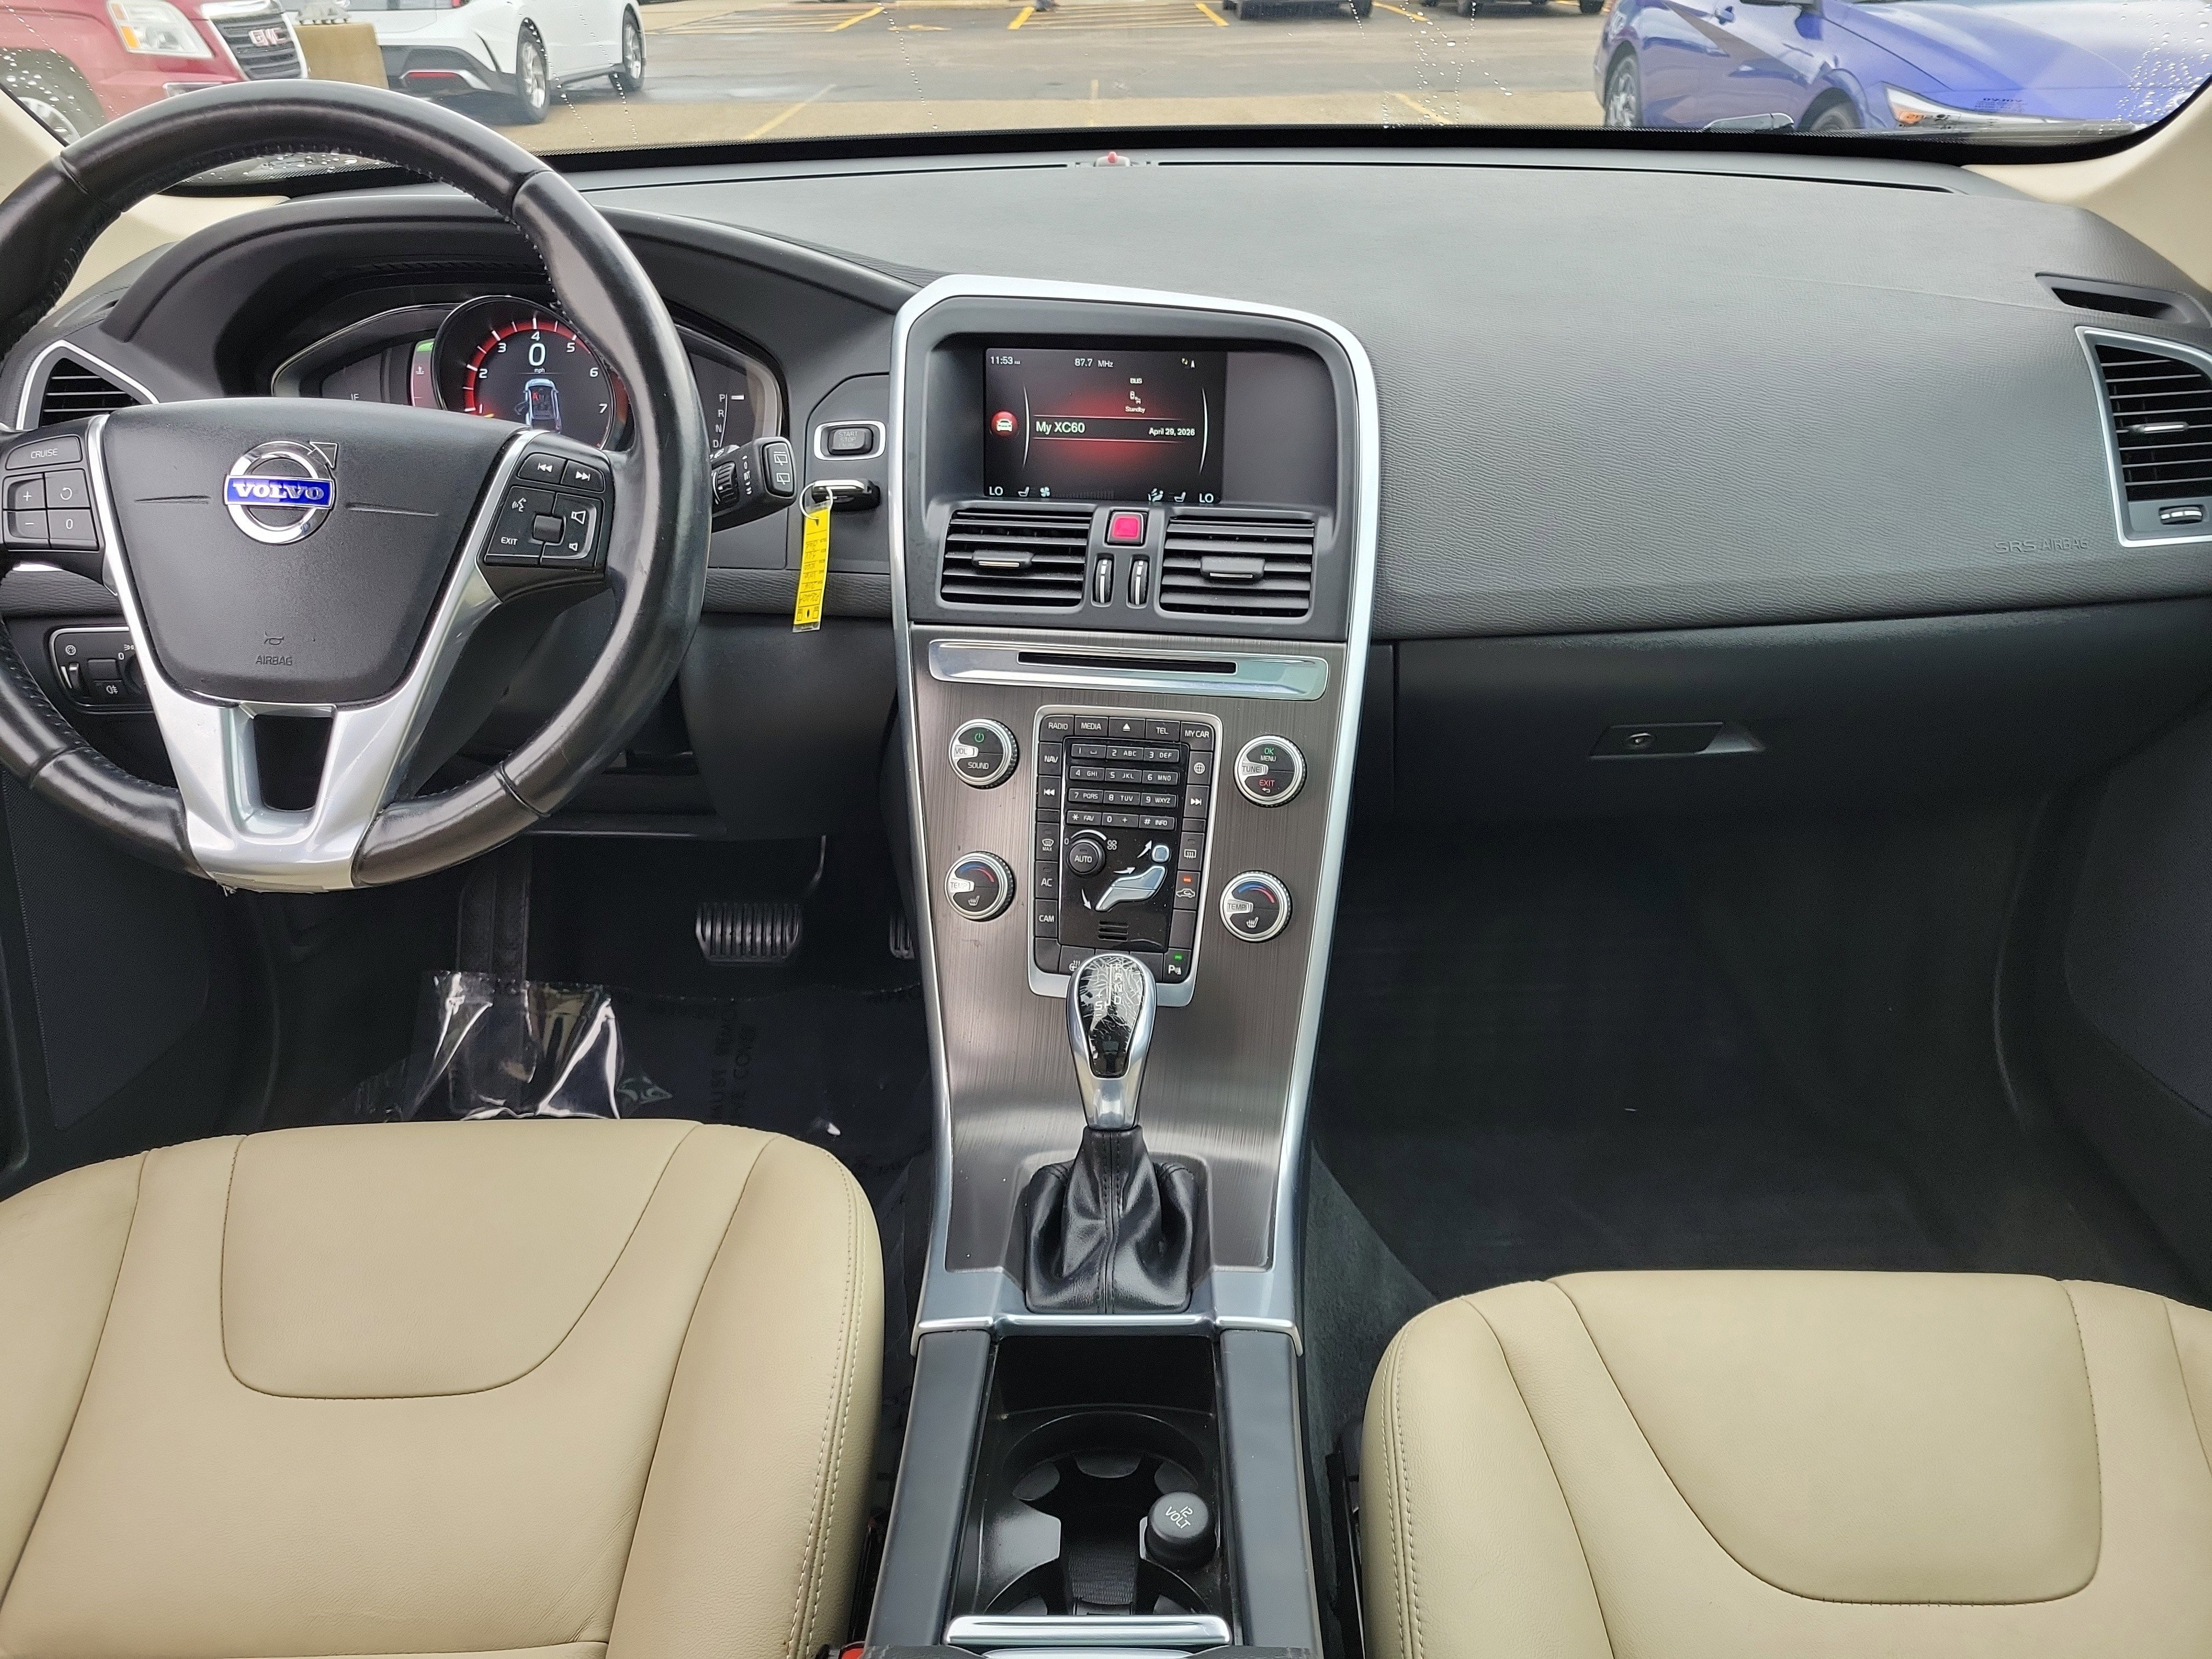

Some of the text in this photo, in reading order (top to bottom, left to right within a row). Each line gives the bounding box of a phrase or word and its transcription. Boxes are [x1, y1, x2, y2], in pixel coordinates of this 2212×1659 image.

[249, 28, 288, 46] GMC
[531, 331, 540, 341] 4
[498, 343, 506, 353] 3
[567, 343, 575, 353] 5
[528, 343, 546, 366] 0
[990, 356, 1013, 365] 11:53
[1075, 358, 1093, 367] 87.7
[479, 369, 488, 379] 2
[590, 368, 599, 377] 6
[719, 394, 725, 402] P
[599, 404, 607, 413] 7
[715, 424, 722, 432] N
[1036, 421, 1085, 435] My XC60
[1165, 428, 1176, 437] 29,
[1178, 428, 1195, 436] 2026
[713, 439, 719, 448] D
[31, 448, 58, 459] CRUISE
[233, 483, 324, 500] VOLVO
[989, 487, 1003, 496] LO
[1199, 493, 1214, 503] LO
[501, 537, 518, 545] EXIT
[1995, 537, 2088, 554] SRS AIRBAG
[256, 655, 292, 665] AIRBAG
[1074, 855, 1092, 863] AUTO
[1041, 878, 1052, 887] AC
[1039, 915, 1054, 923] CAM
[1114, 984, 1123, 992] N
[1114, 996, 1121, 1005] D
[1096, 1001, 1103, 1011] S
[1180, 1506, 1193, 1518] 12
[1165, 1506, 1191, 1529] VOLT
